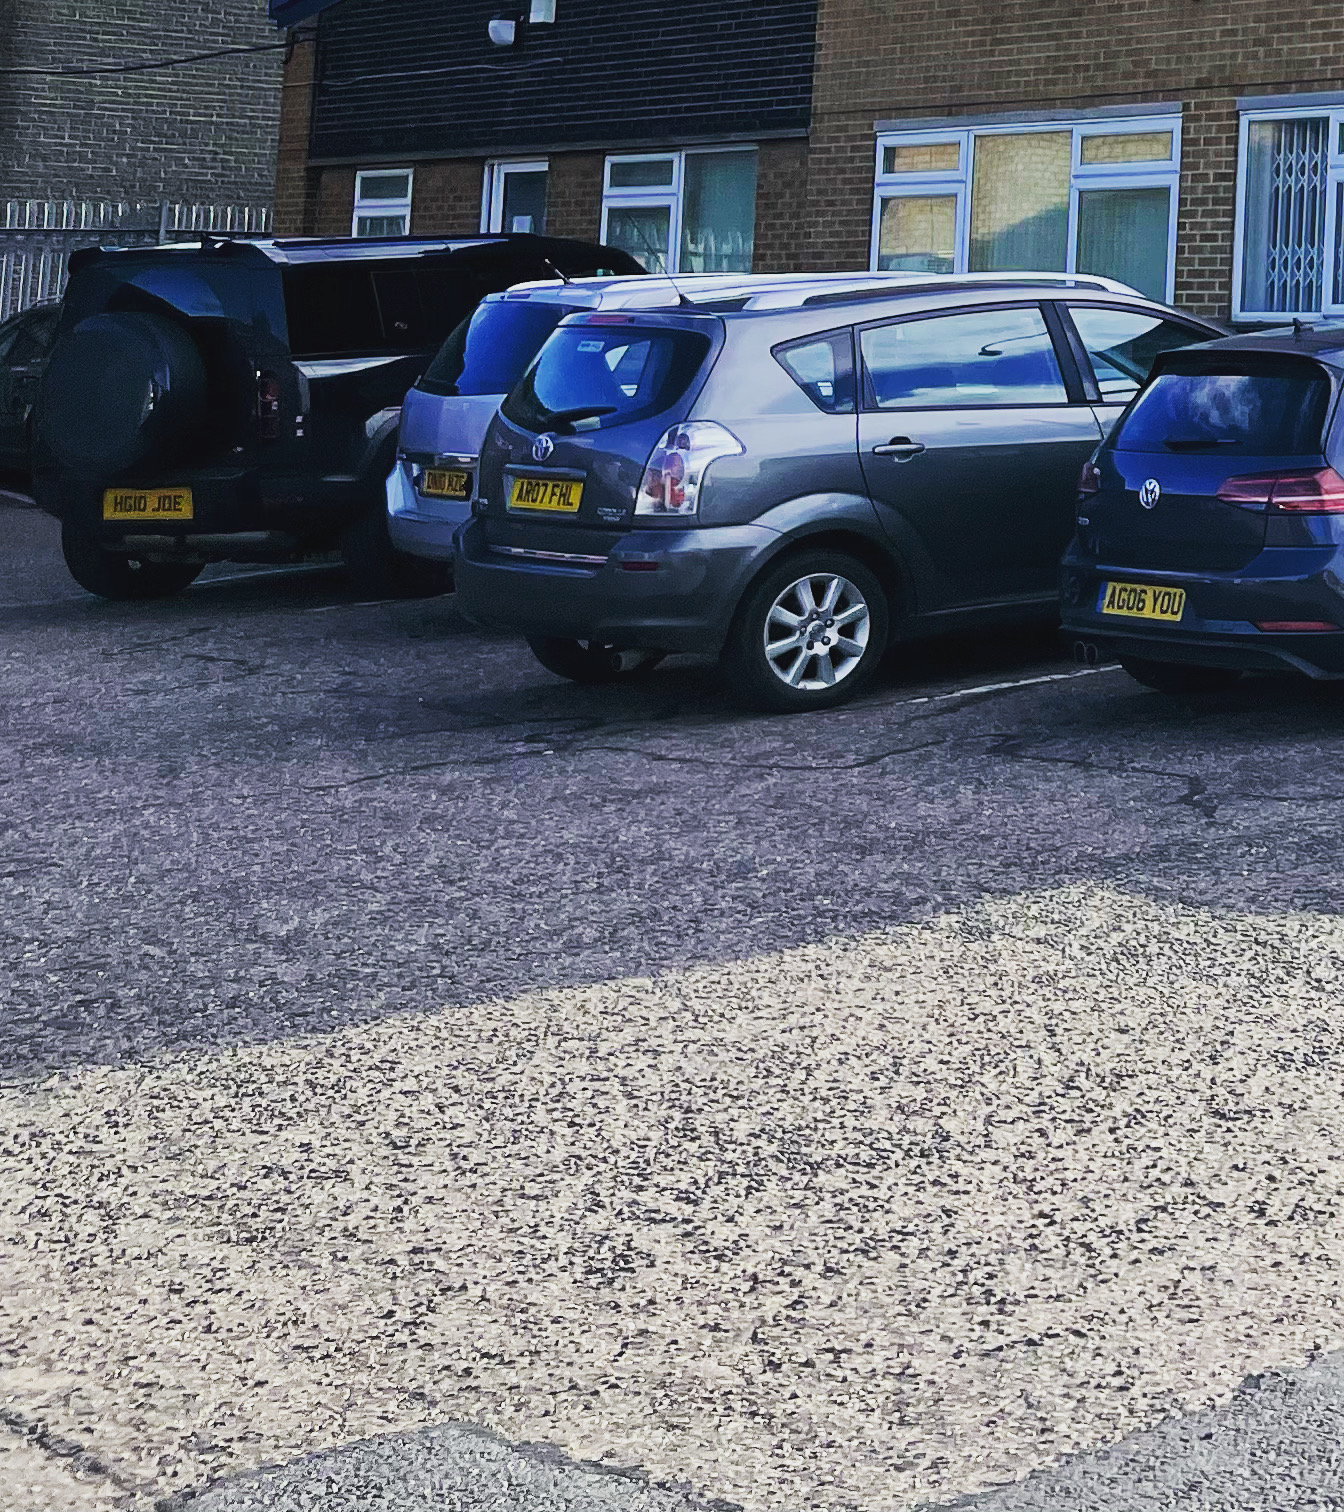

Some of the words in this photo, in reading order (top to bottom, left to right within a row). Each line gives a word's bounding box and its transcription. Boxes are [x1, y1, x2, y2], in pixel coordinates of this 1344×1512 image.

[515, 481, 549, 504] AR07
[548, 483, 574, 506] FHL
[1106, 585, 1147, 611] AG06
[1151, 590, 1183, 616] YOU
